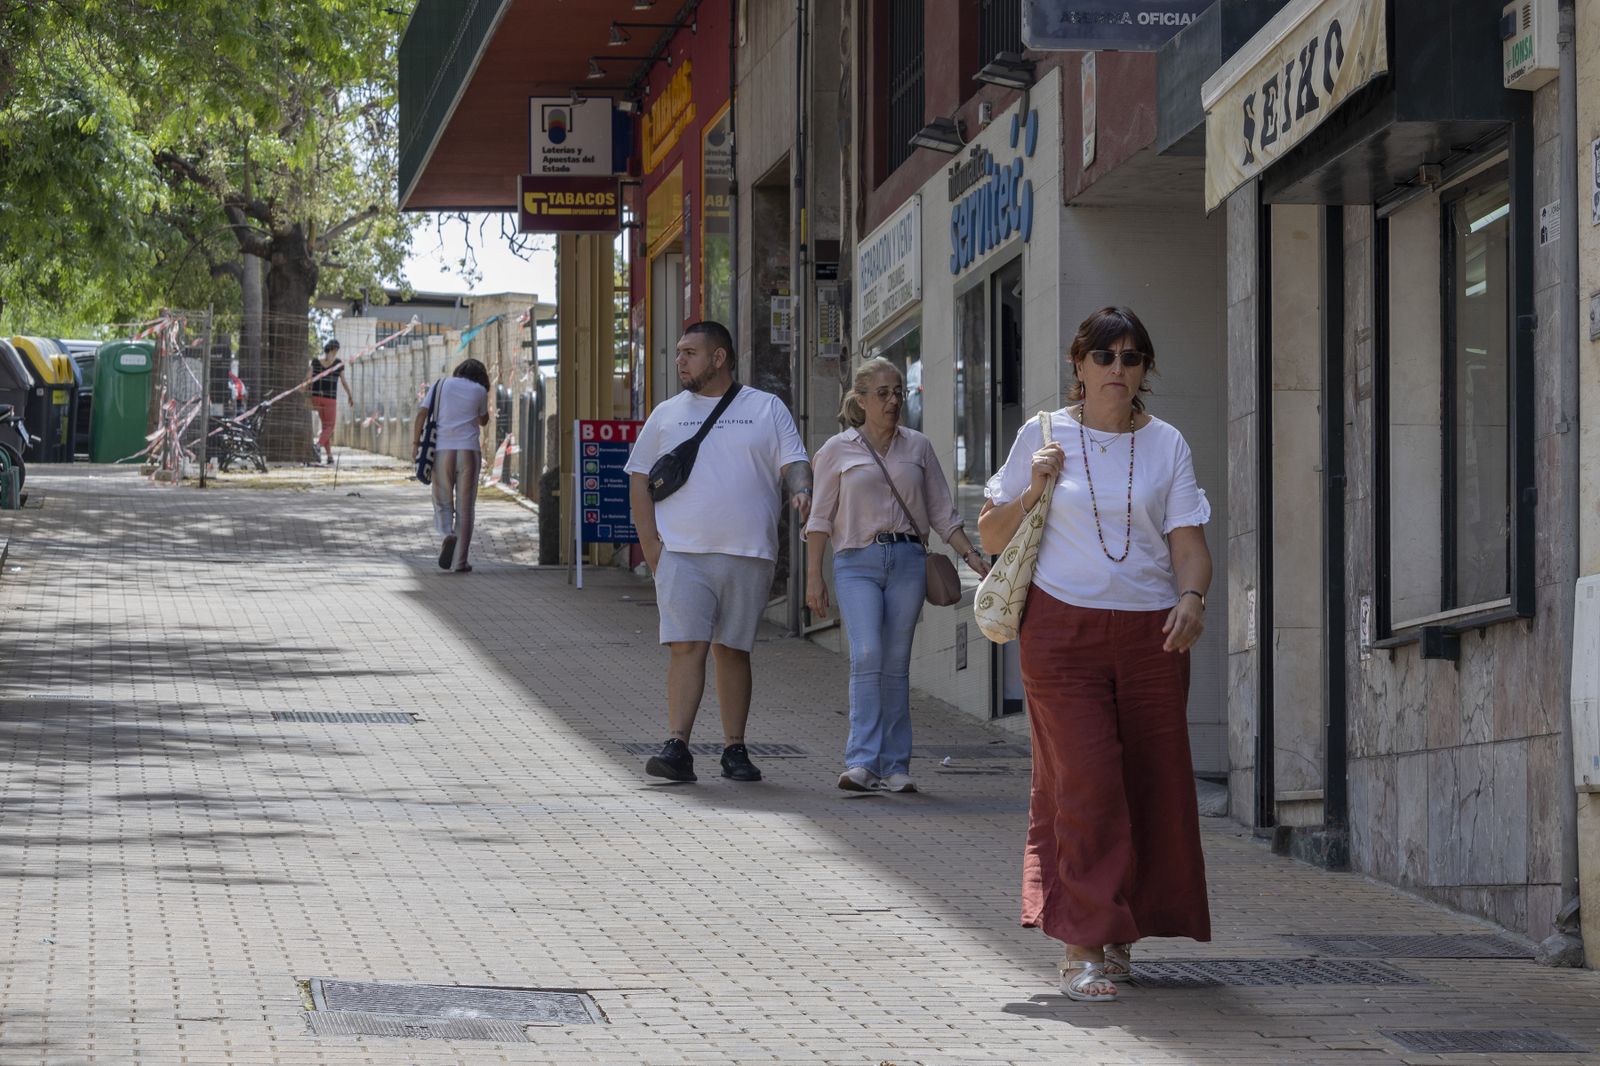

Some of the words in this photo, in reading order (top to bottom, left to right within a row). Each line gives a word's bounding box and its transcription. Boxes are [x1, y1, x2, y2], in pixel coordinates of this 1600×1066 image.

[1242, 18, 1345, 167] SEIKO
[577, 147, 583, 155] y
[542, 156, 580, 164] Apuestas
[547, 192, 615, 205] TABACOS
